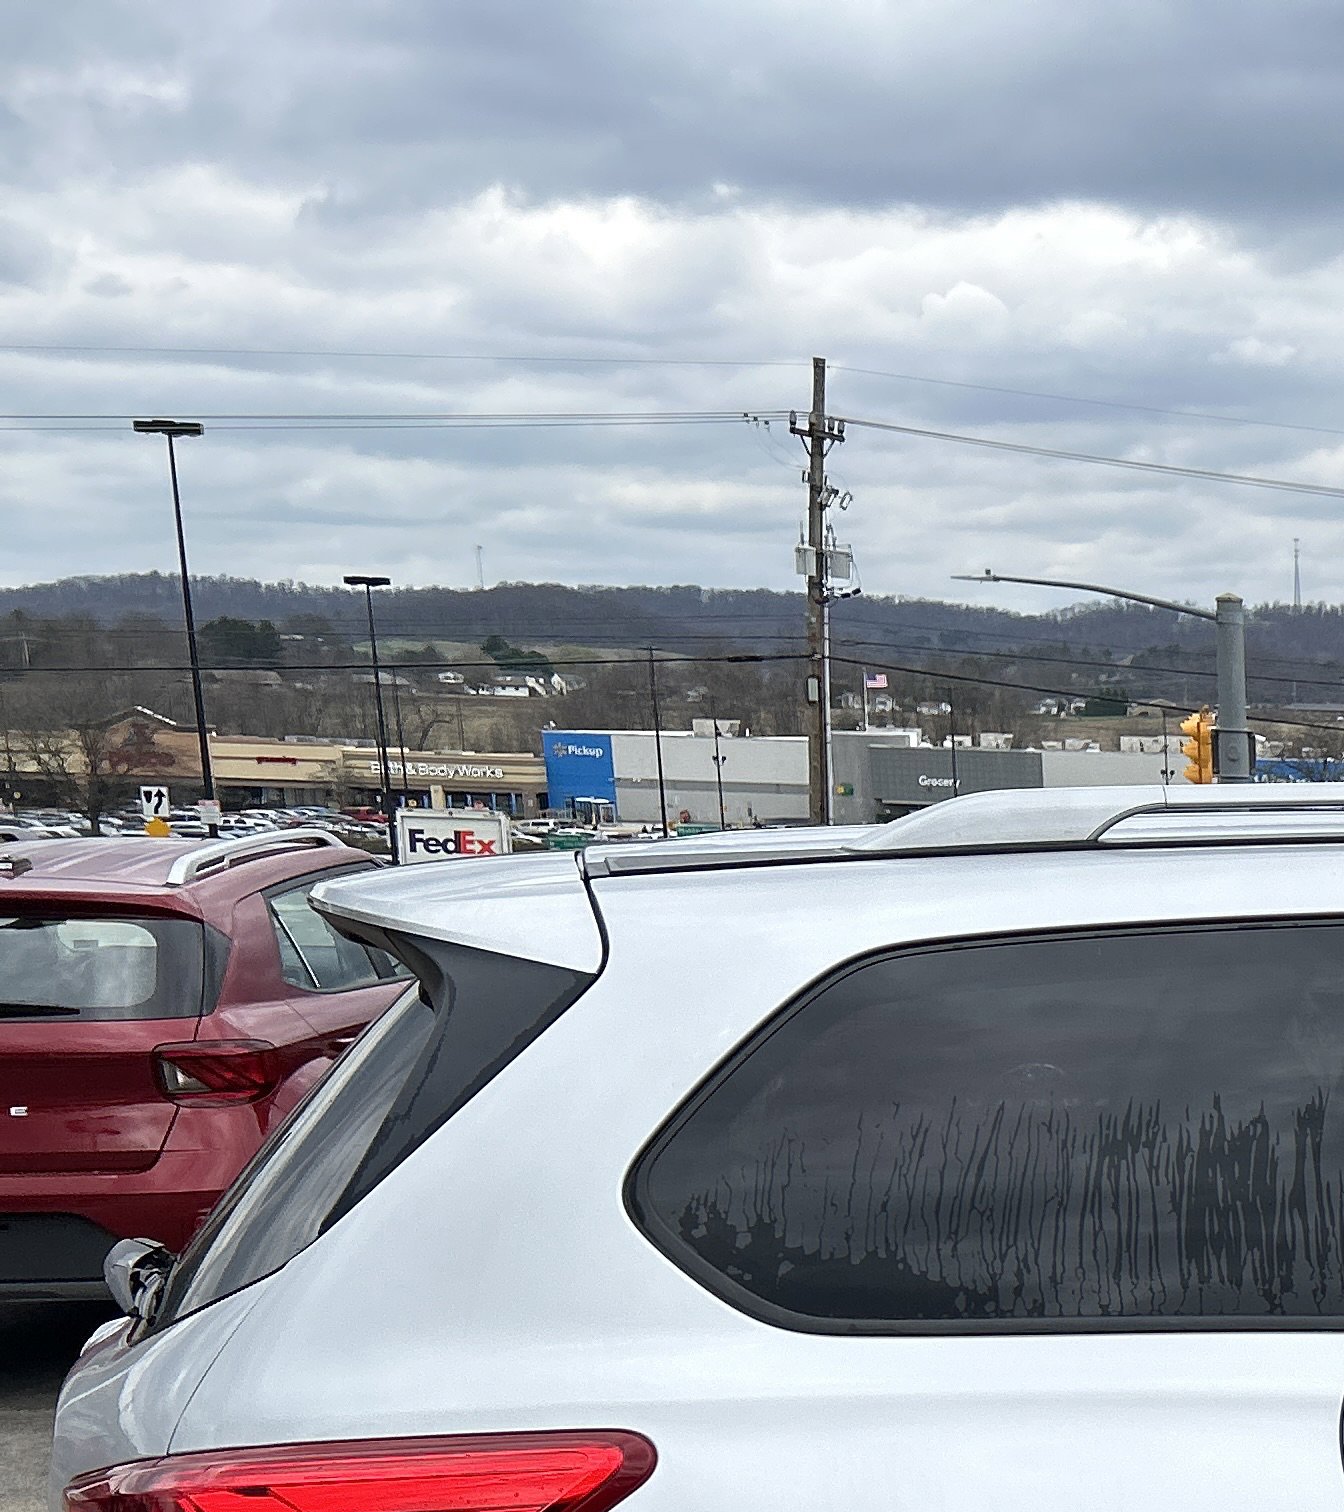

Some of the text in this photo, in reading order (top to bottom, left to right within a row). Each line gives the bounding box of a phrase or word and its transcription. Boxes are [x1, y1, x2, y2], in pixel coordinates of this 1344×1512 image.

[567, 744, 604, 759] Pickup
[369, 761, 504, 779] Bth & Body Works
[407, 828, 496, 855] FedEx
